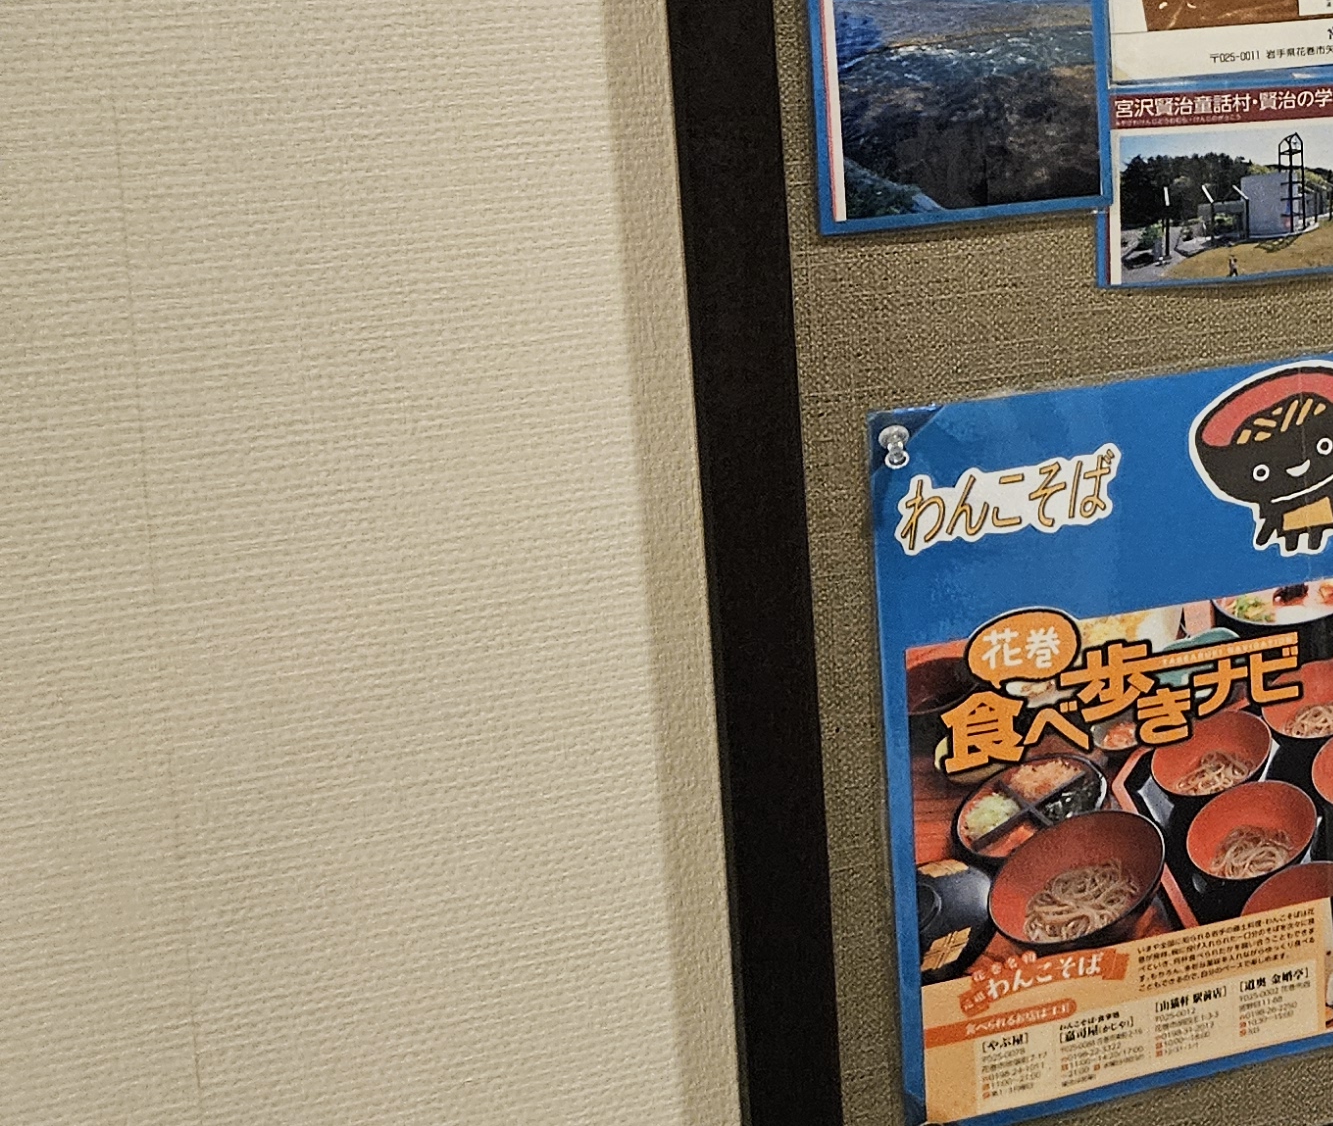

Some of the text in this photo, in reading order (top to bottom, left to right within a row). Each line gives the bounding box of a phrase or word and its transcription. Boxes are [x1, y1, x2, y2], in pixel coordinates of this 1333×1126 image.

[901, 448, 1115, 550] わんこそば
[981, 626, 1061, 670] 花巻
[941, 642, 1300, 773] 食べ歩きナビ
[987, 954, 1104, 999] わんこそば
